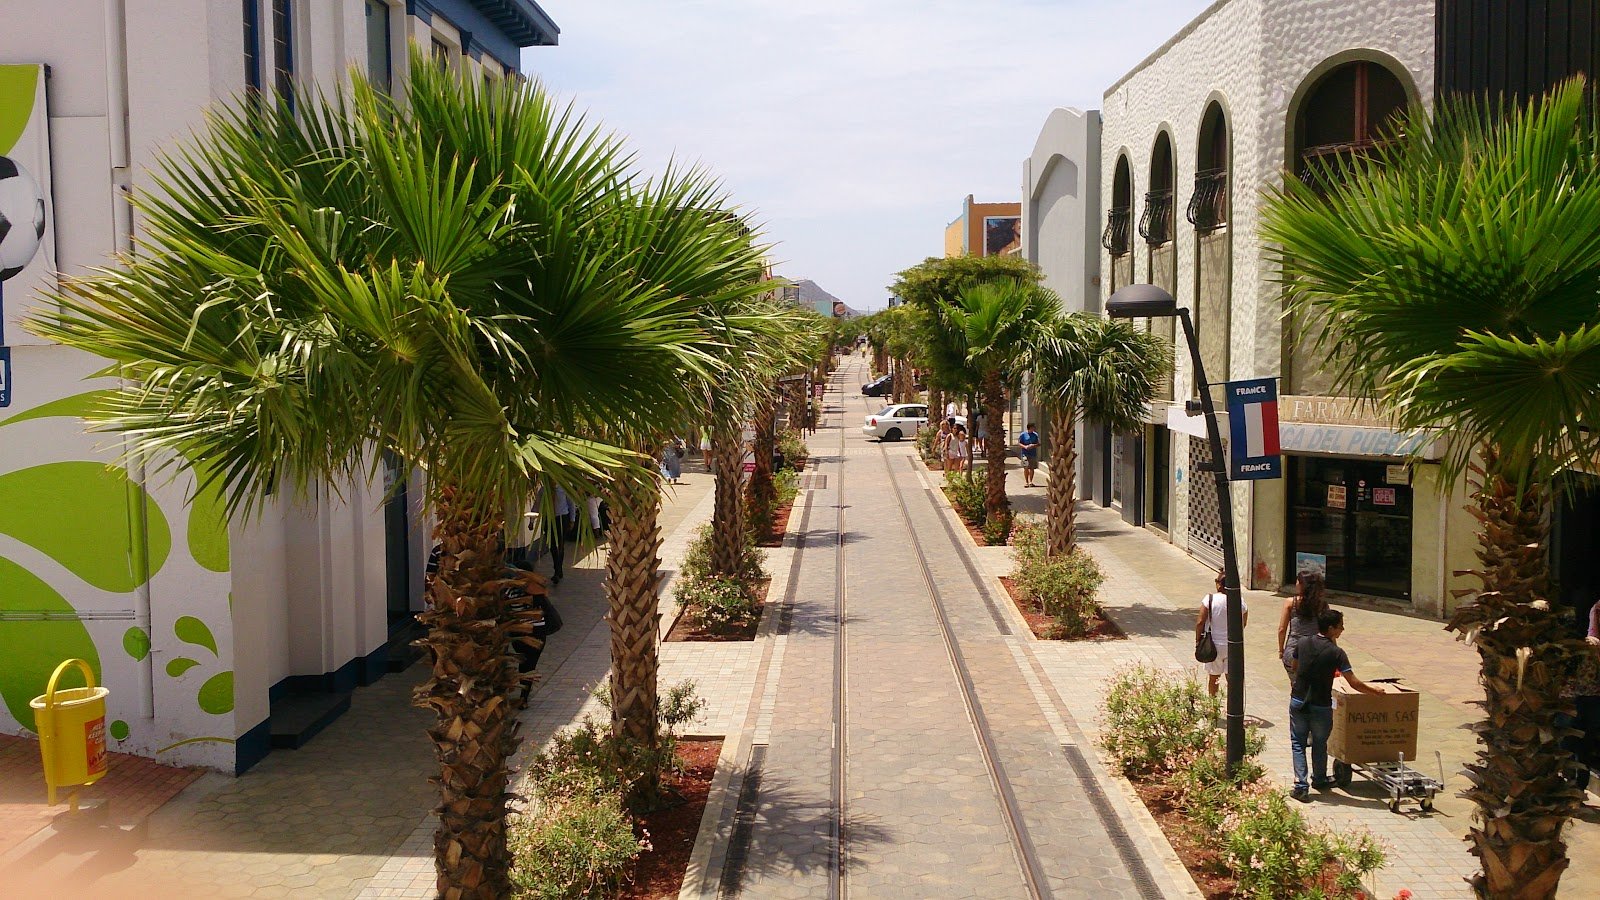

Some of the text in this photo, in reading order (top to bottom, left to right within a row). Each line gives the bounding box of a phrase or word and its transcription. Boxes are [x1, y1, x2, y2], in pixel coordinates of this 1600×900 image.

[1236, 386, 1266, 396] FRANCE
[1307, 428, 1343, 451] DEL
[1241, 463, 1271, 472] FRANCE
[1348, 711, 1387, 723] NALSANI
